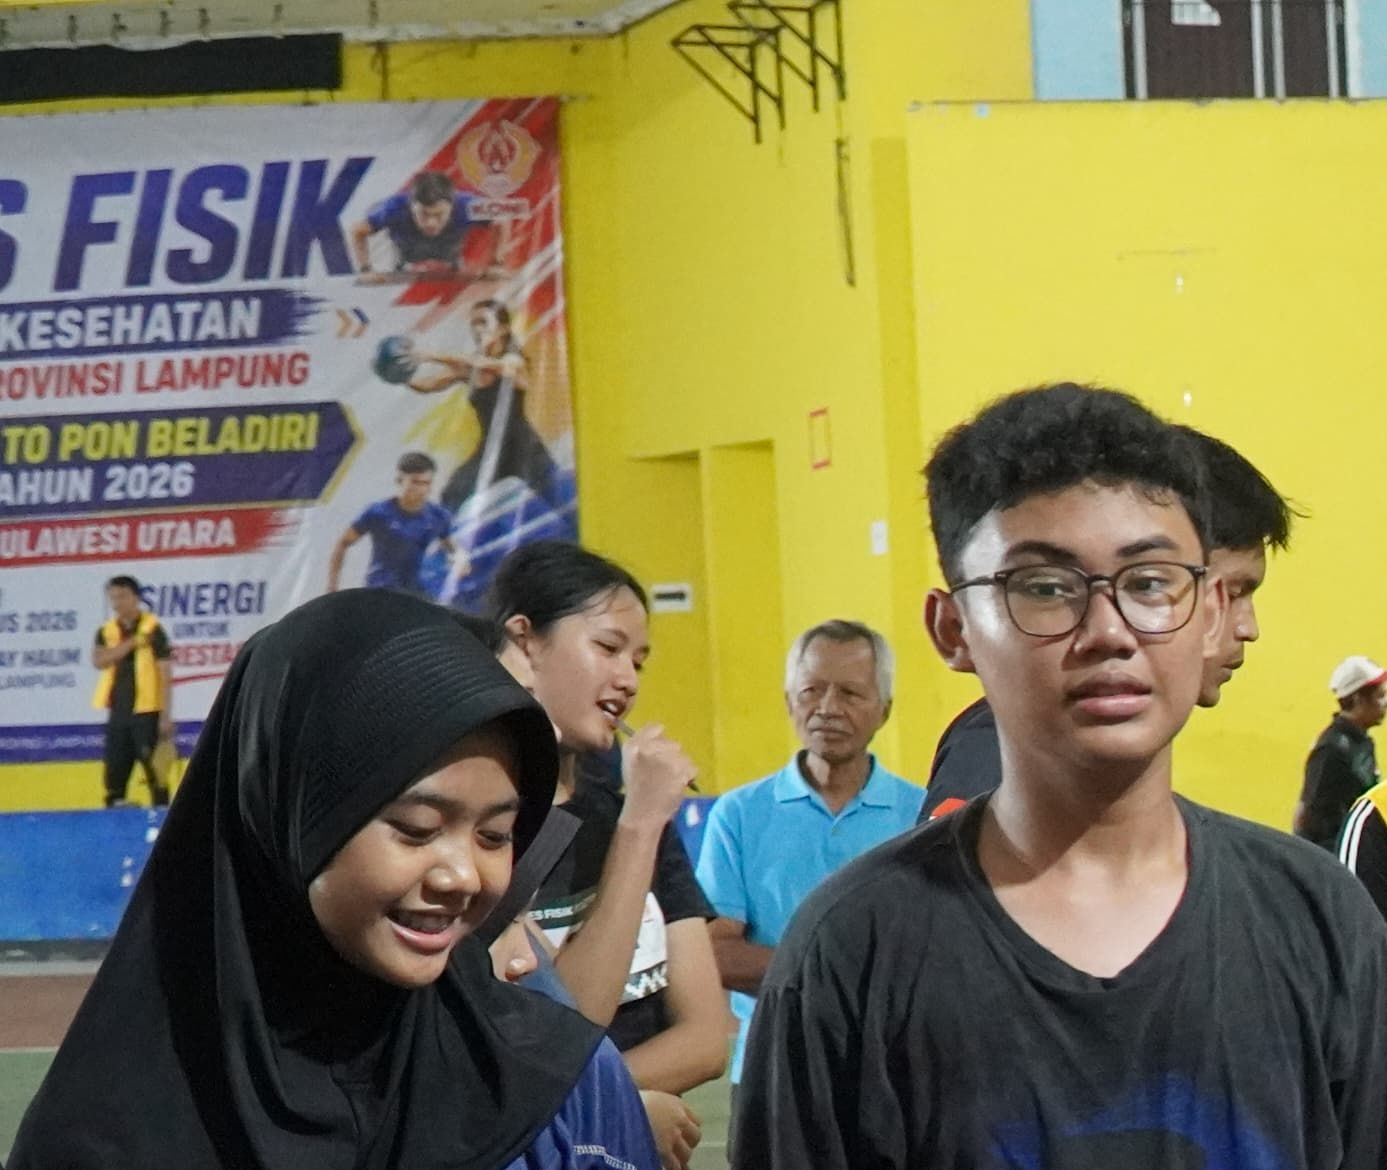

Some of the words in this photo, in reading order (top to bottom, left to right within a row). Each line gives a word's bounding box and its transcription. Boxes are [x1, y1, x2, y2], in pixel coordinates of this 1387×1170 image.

[54, 157, 375, 292] FISIK
[0, 298, 261, 351] KESEHATAN
[136, 353, 310, 393] LAMPUNG
[4, 425, 50, 464] TO
[59, 419, 139, 462] PON
[146, 411, 320, 457] BELADIRI
[104, 461, 195, 500] 2026
[138, 518, 236, 551] UTARA
[140, 580, 267, 617] SINERGI
